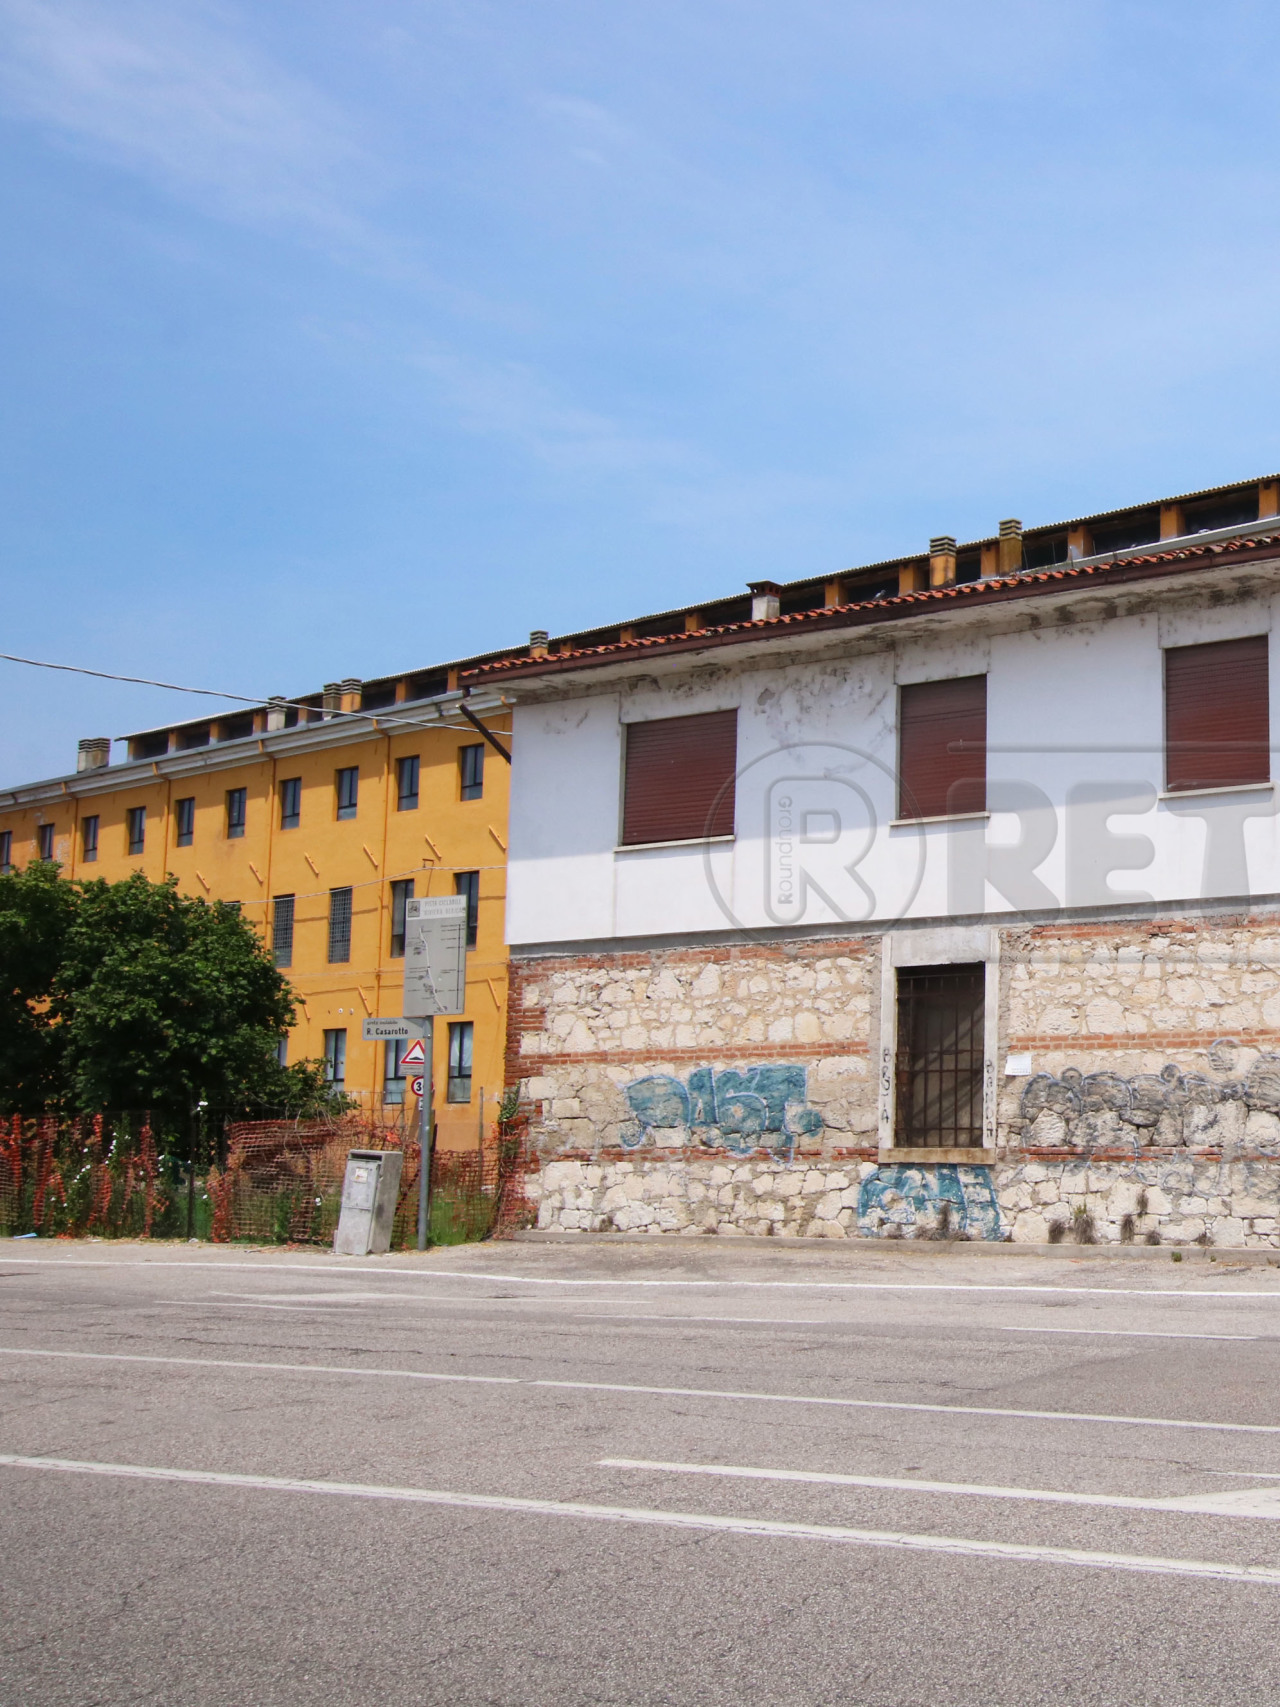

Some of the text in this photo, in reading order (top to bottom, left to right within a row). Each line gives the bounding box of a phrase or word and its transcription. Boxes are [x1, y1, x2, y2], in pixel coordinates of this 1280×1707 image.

[366, 1026, 409, 1036] R. Casarotto
[416, 1082, 424, 1092] 3
